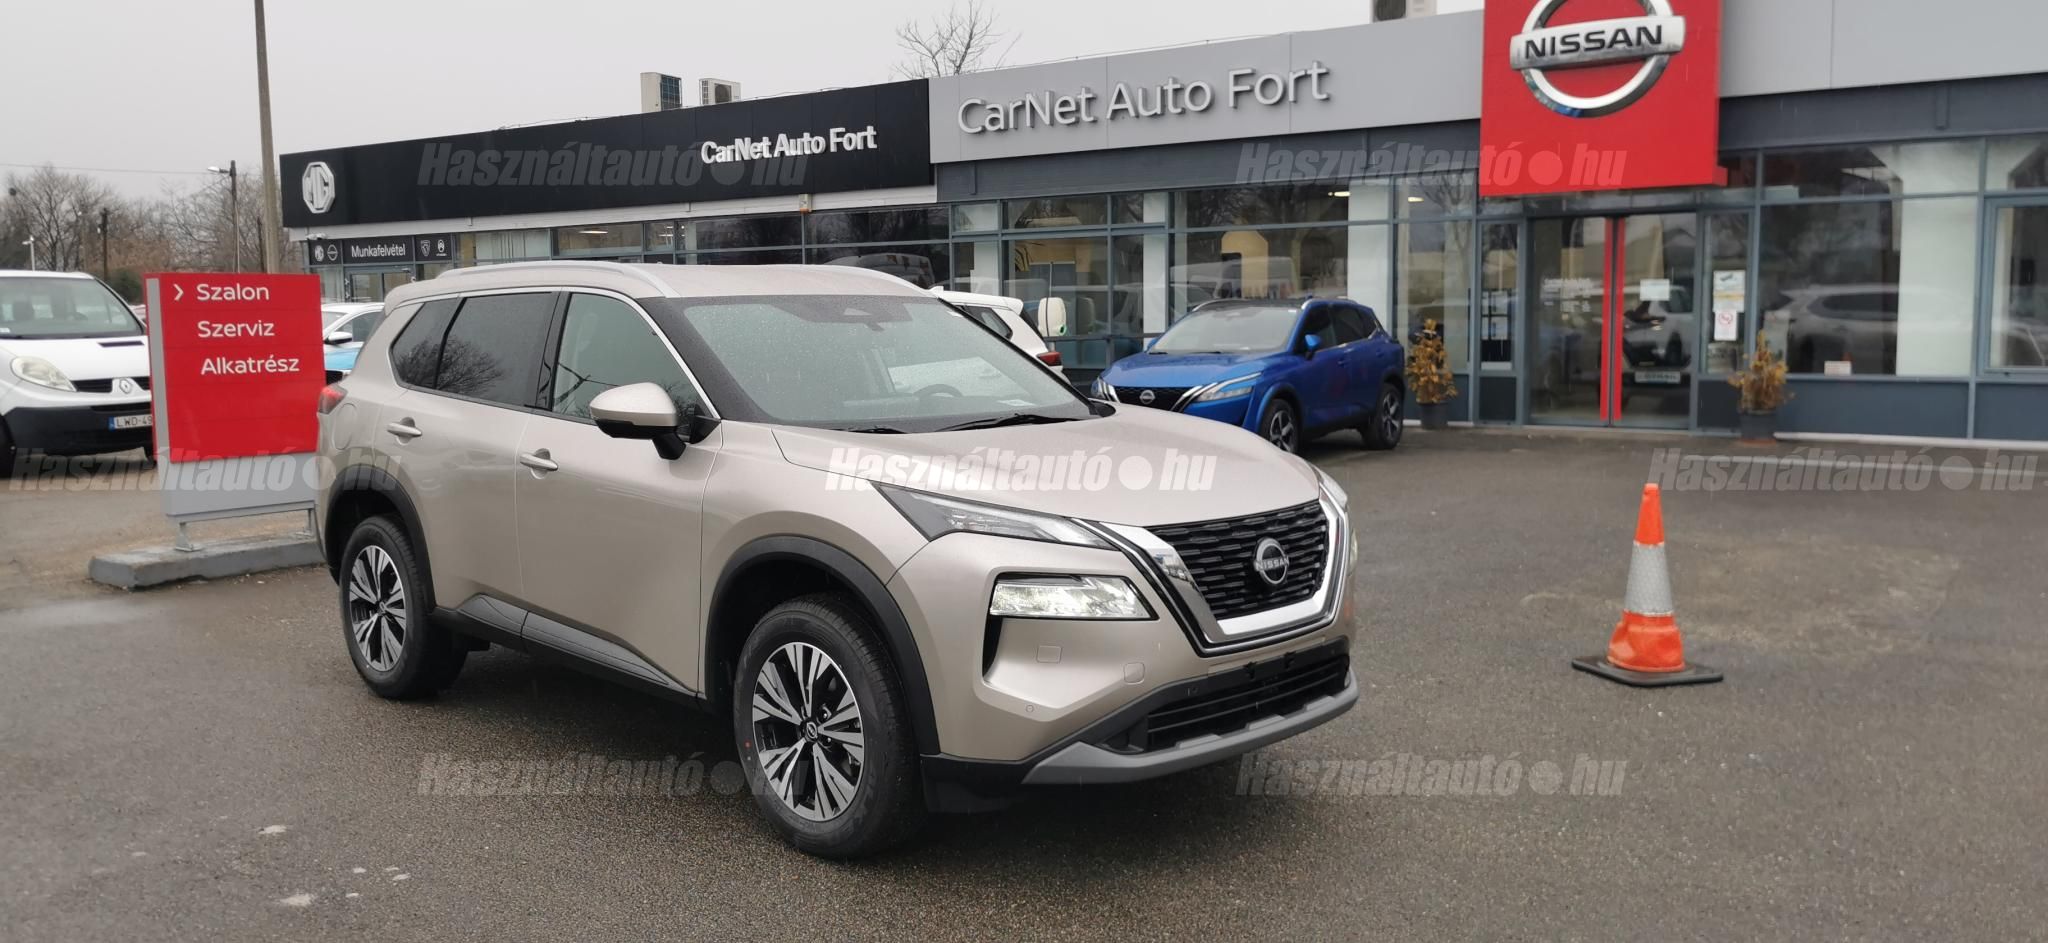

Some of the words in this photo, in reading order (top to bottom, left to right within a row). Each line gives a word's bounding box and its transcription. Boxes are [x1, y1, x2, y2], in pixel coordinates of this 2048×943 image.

[1525, 25, 1663, 60] NISSAN
[957, 86, 1098, 135] CarNet
[1106, 75, 1213, 119] Auto
[1229, 60, 1330, 108] Fort
[701, 135, 773, 165] CarNet
[773, 132, 827, 158] Auto
[829, 125, 878, 152] Fort
[351, 243, 406, 258] Munkafelvétel
[196, 283, 270, 301] Szalon
[197, 320, 275, 338] Szerviz
[200, 353, 300, 376] Alkatrész
[1254, 555, 1290, 571] NISSAN
